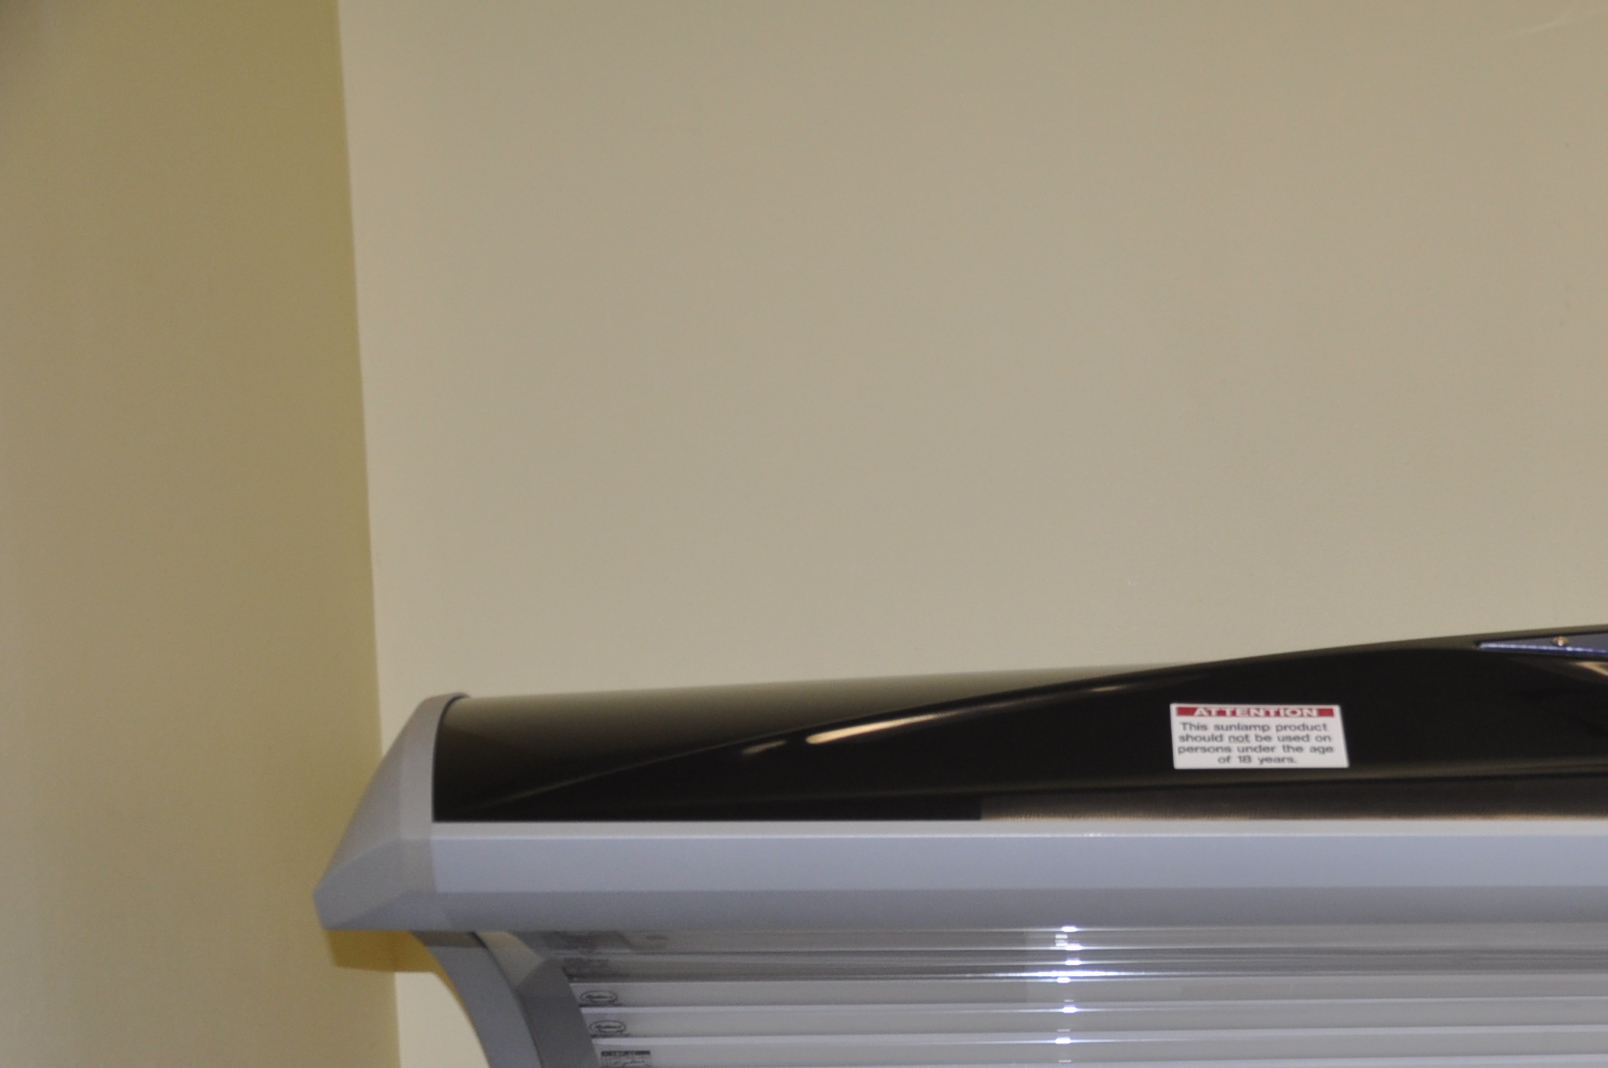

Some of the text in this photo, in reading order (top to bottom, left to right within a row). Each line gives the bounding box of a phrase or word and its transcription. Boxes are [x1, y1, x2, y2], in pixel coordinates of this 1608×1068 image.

[1194, 708, 1317, 717] ATTENTION
[1180, 722, 1327, 733] This sunlamp product
[1179, 734, 1223, 743] should
[1228, 735, 1250, 743] not
[1255, 734, 1272, 742] be
[1277, 734, 1310, 742] used
[1178, 744, 1334, 755] persons under the age
[1217, 755, 1297, 765] of 18 years.
